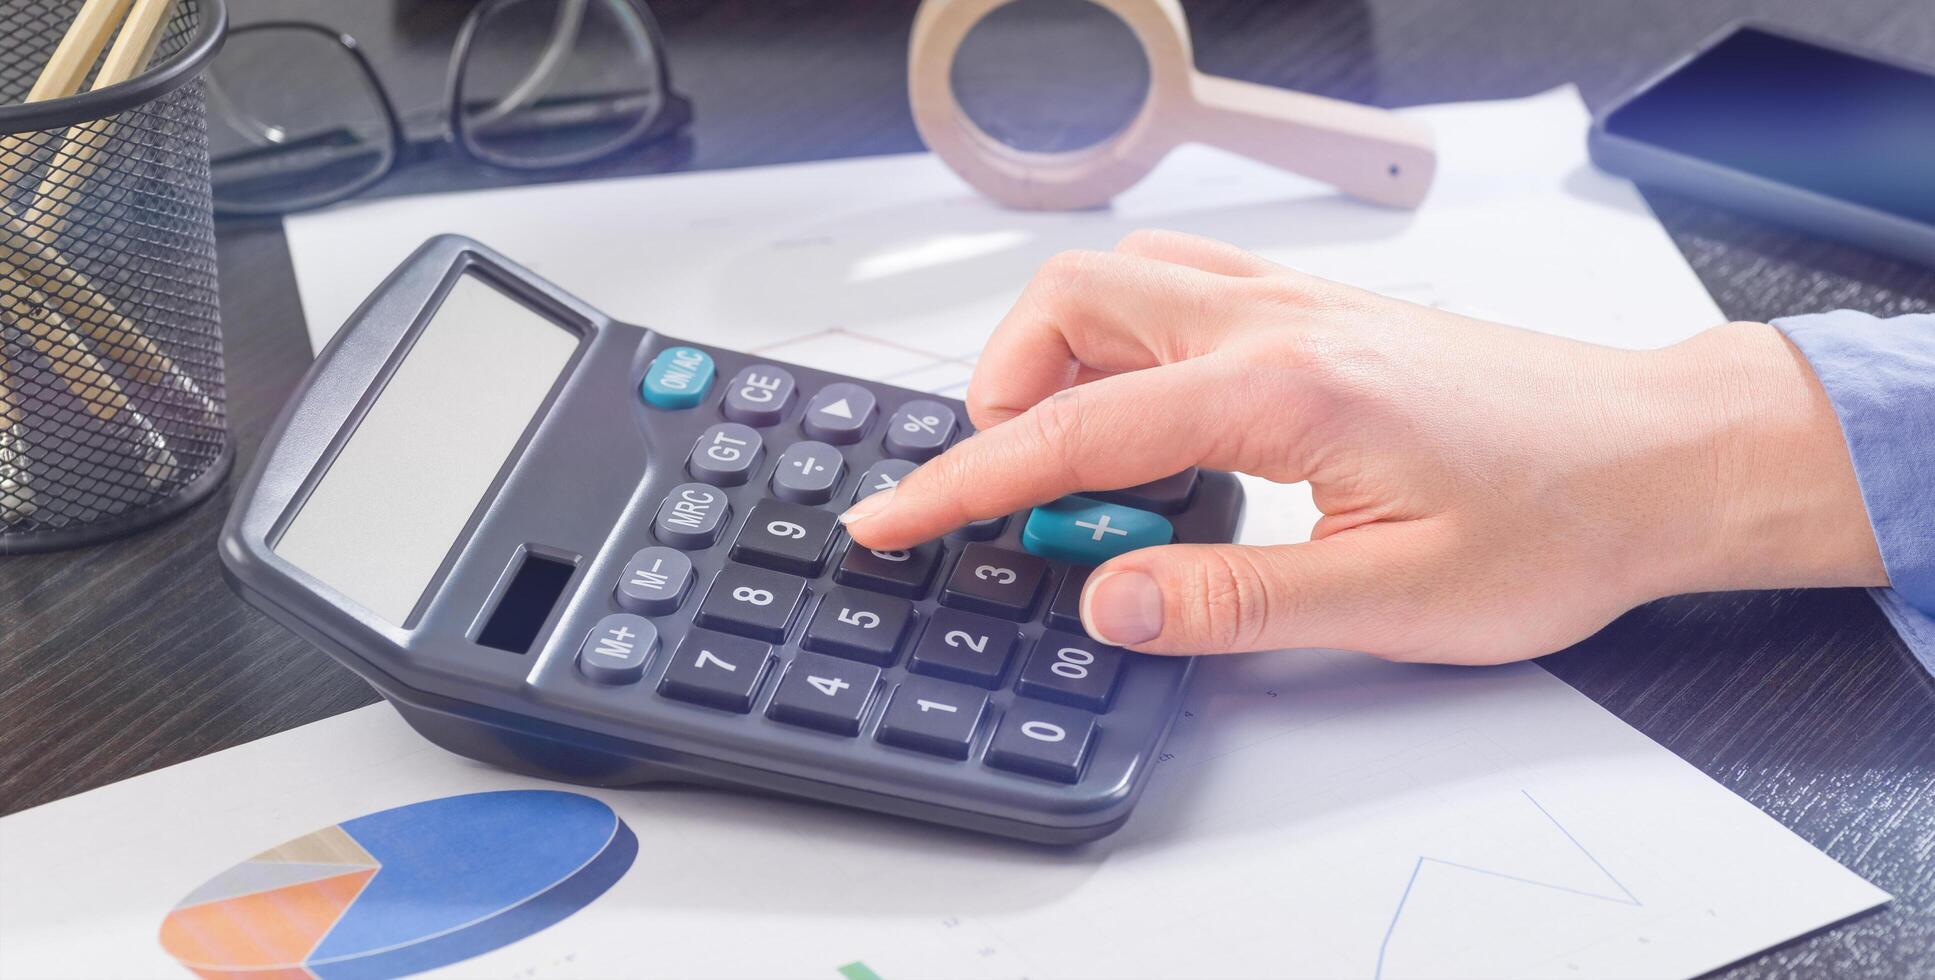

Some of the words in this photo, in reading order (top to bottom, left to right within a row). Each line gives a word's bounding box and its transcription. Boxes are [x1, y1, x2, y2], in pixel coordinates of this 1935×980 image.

[660, 350, 703, 390] ON/AC
[740, 373, 781, 402] CE
[903, 414, 940, 434] %
[707, 432, 747, 461] GT
[668, 490, 714, 528] MRC
[767, 520, 806, 539] 9
[631, 559, 668, 590] M-
[975, 564, 1017, 584] 3
[732, 586, 774, 606] 8
[838, 608, 880, 629] 5
[595, 626, 635, 659] M+
[944, 630, 989, 653] 2
[695, 650, 736, 672] 7
[1051, 647, 1094, 679] 00
[807, 675, 849, 696] 4
[917, 698, 957, 712] 1
[1021, 721, 1066, 742] 0
